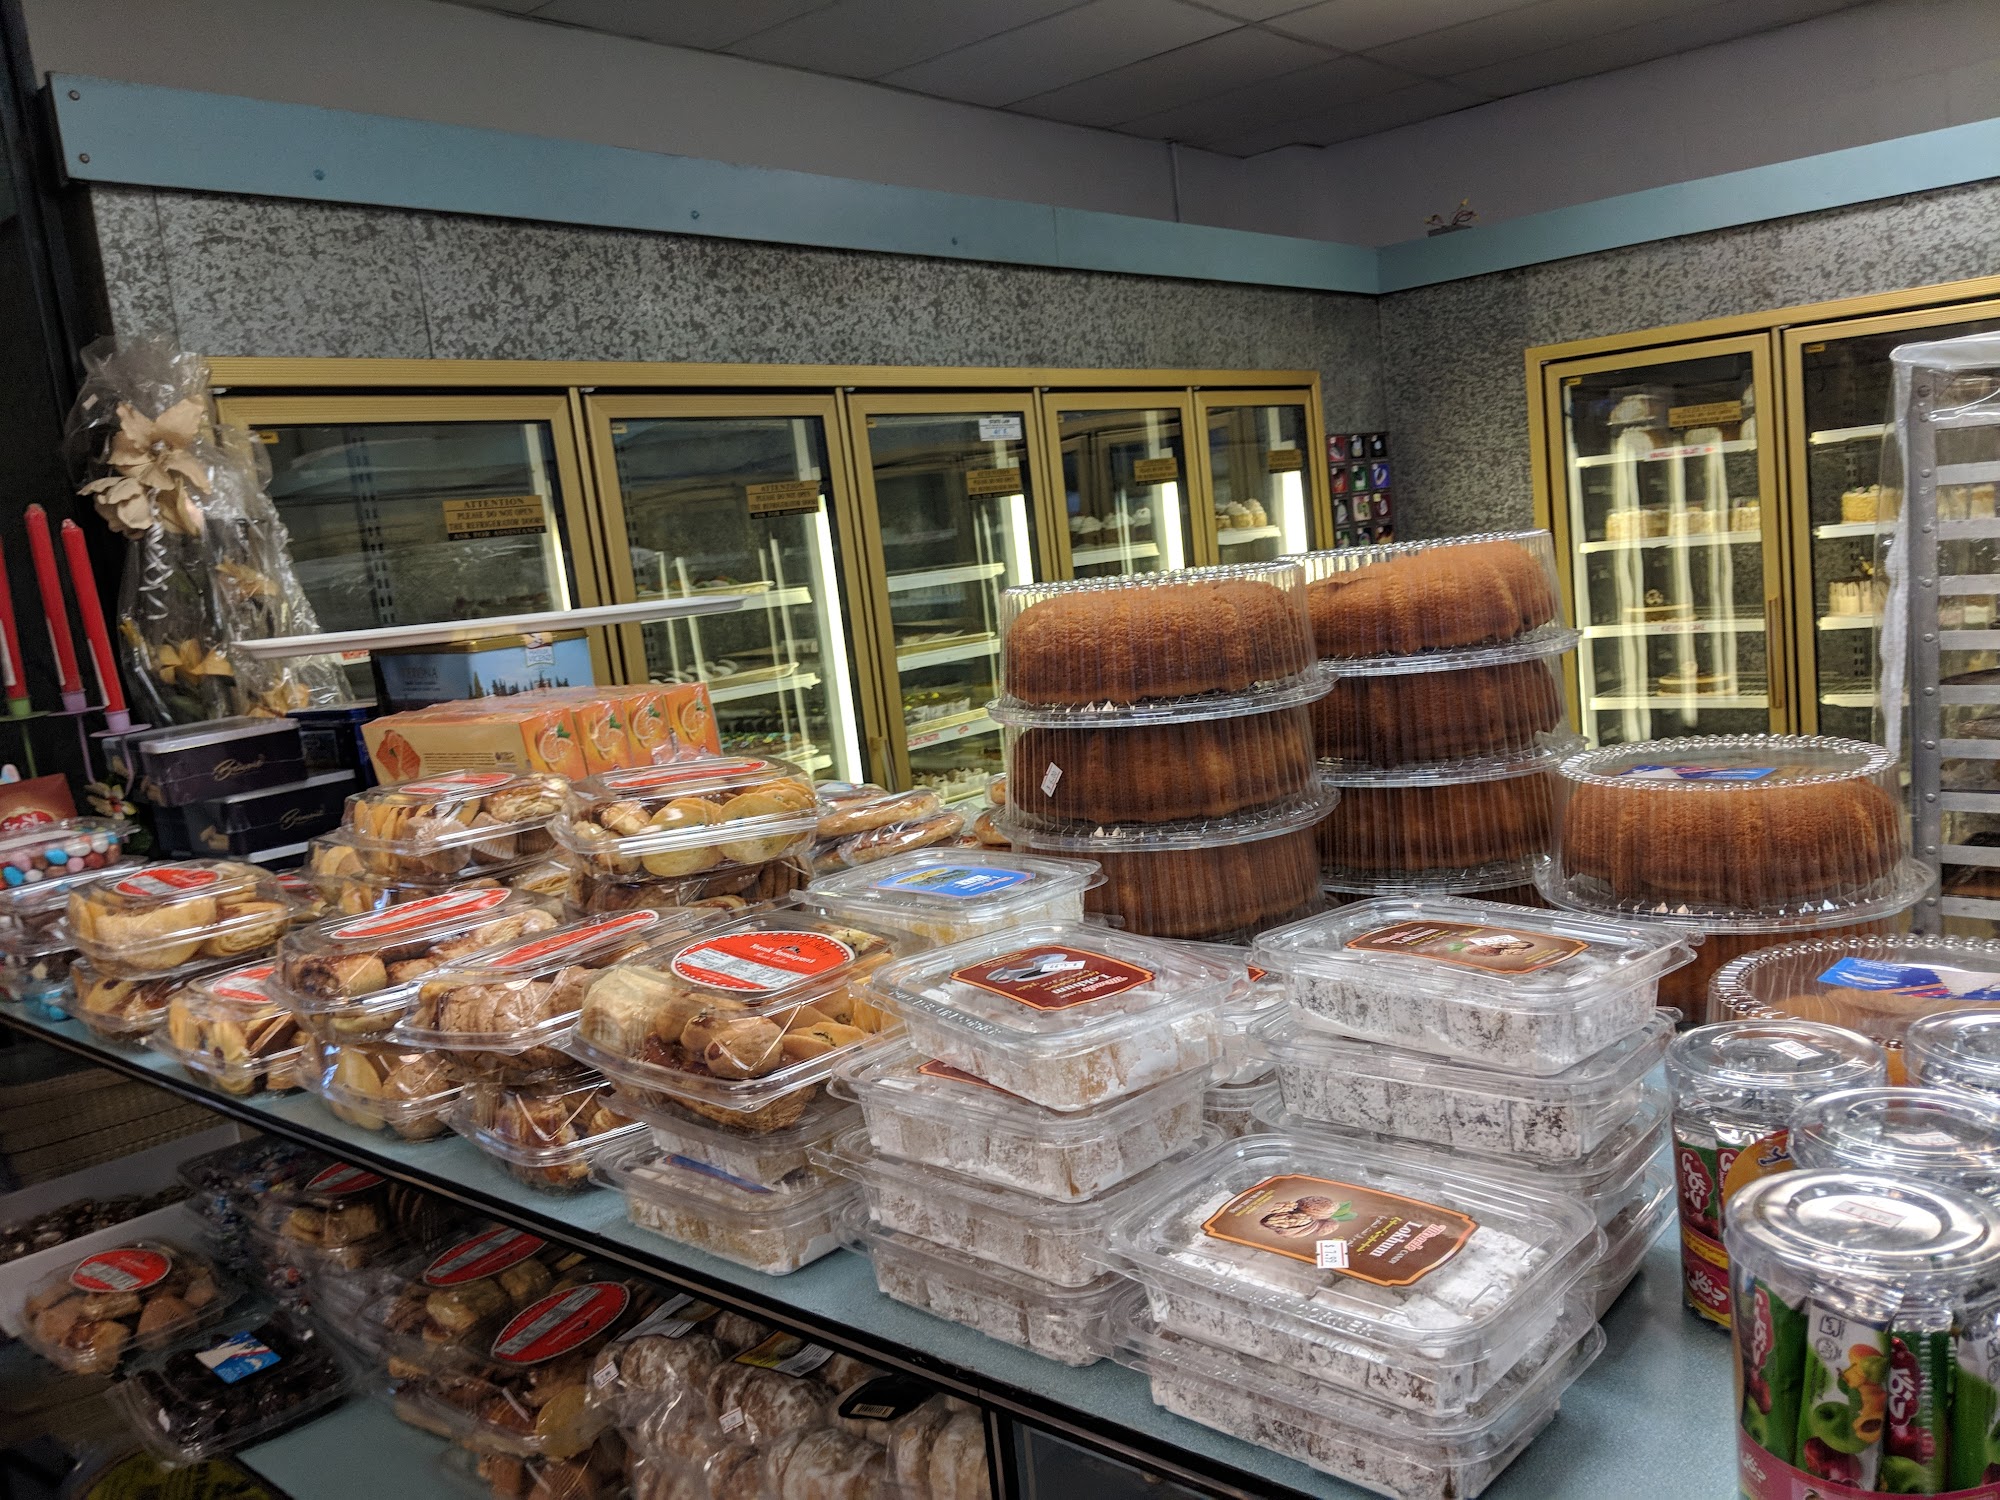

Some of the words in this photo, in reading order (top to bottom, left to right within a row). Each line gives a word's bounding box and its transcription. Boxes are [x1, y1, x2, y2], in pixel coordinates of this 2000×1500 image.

[463, 498, 525, 510] ATTENTION
[456, 511, 484, 521] PLEASE
[486, 510, 497, 518] DO
[498, 508, 514, 517] NOT
[514, 507, 533, 517] OPEN
[448, 523, 464, 532] THE
[1051, 973, 1112, 995] Lokhum
[1369, 1221, 1423, 1257] Lokhum
[1404, 1223, 1447, 1252] Miracle
